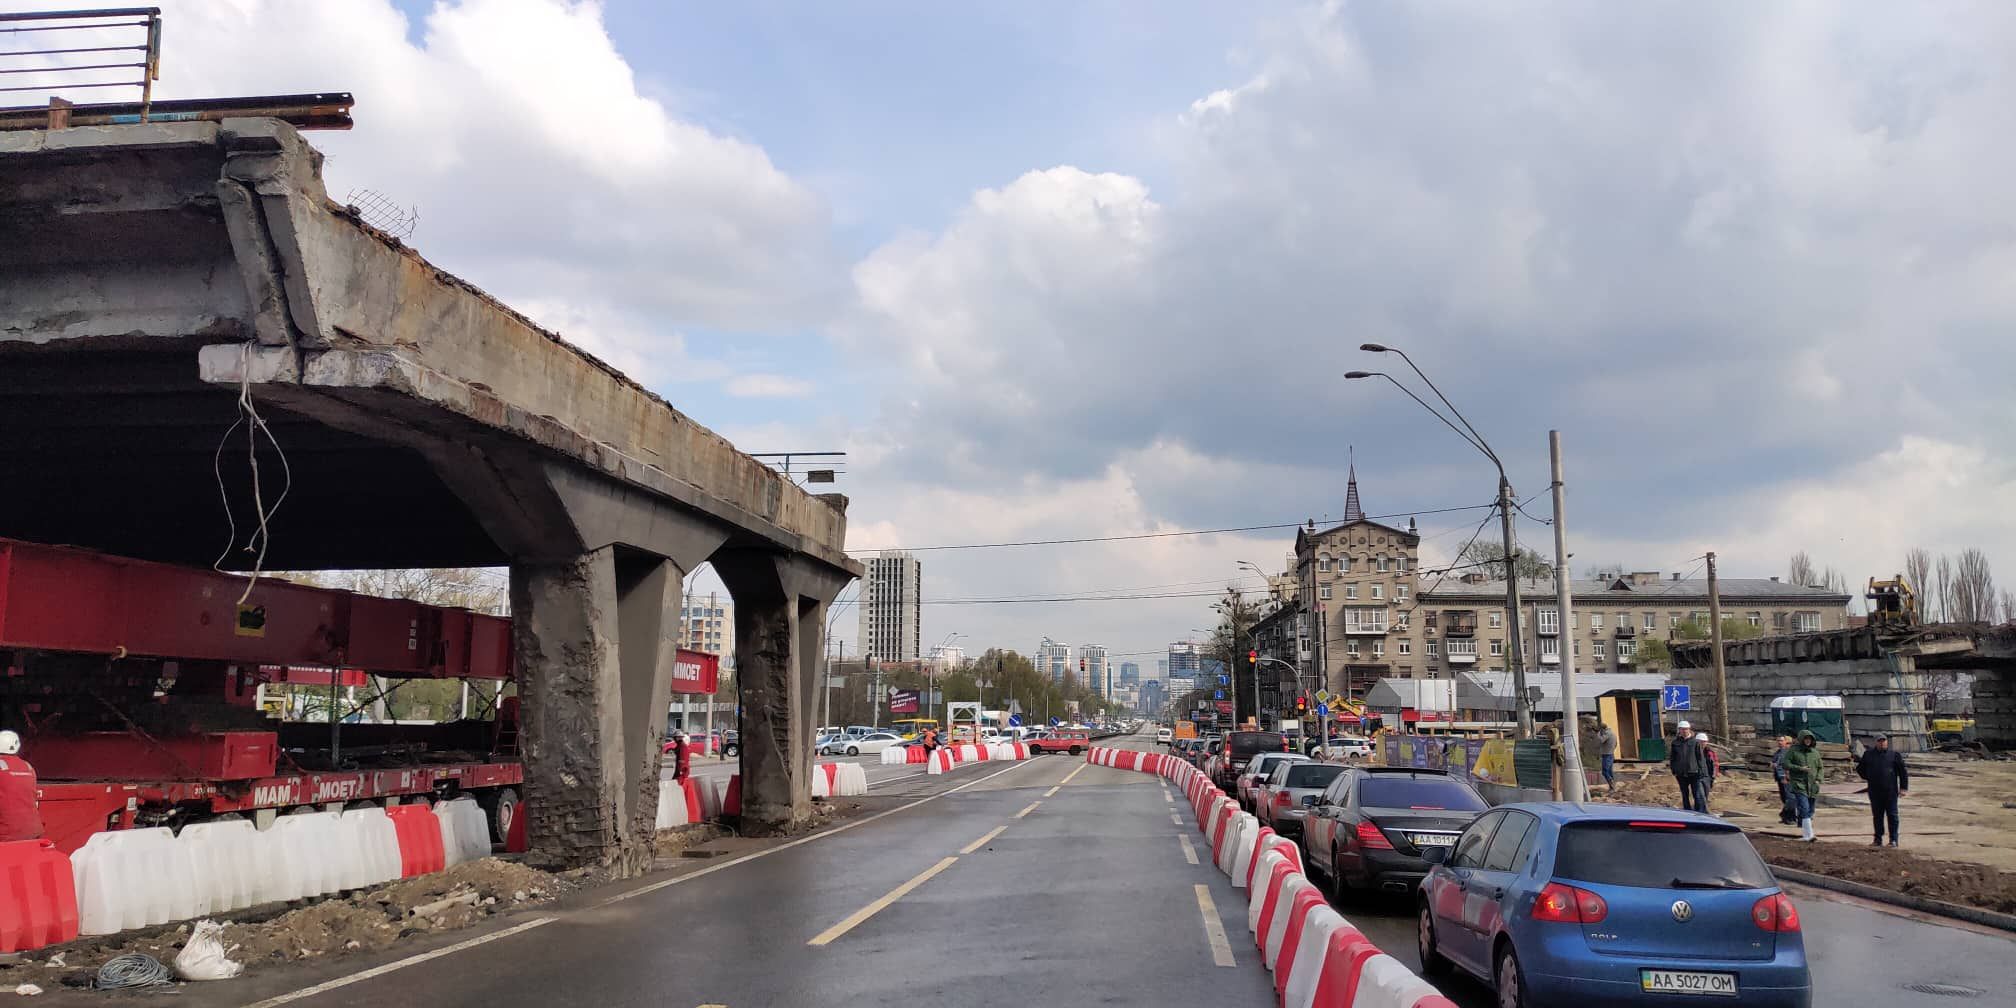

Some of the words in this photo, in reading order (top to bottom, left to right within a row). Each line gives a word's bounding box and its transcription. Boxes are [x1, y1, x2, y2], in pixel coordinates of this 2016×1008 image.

[319, 779, 357, 799] MOET
[1654, 974, 1673, 988] AA
[1677, 974, 1708, 989] 5027
[1711, 976, 1733, 990] OM
